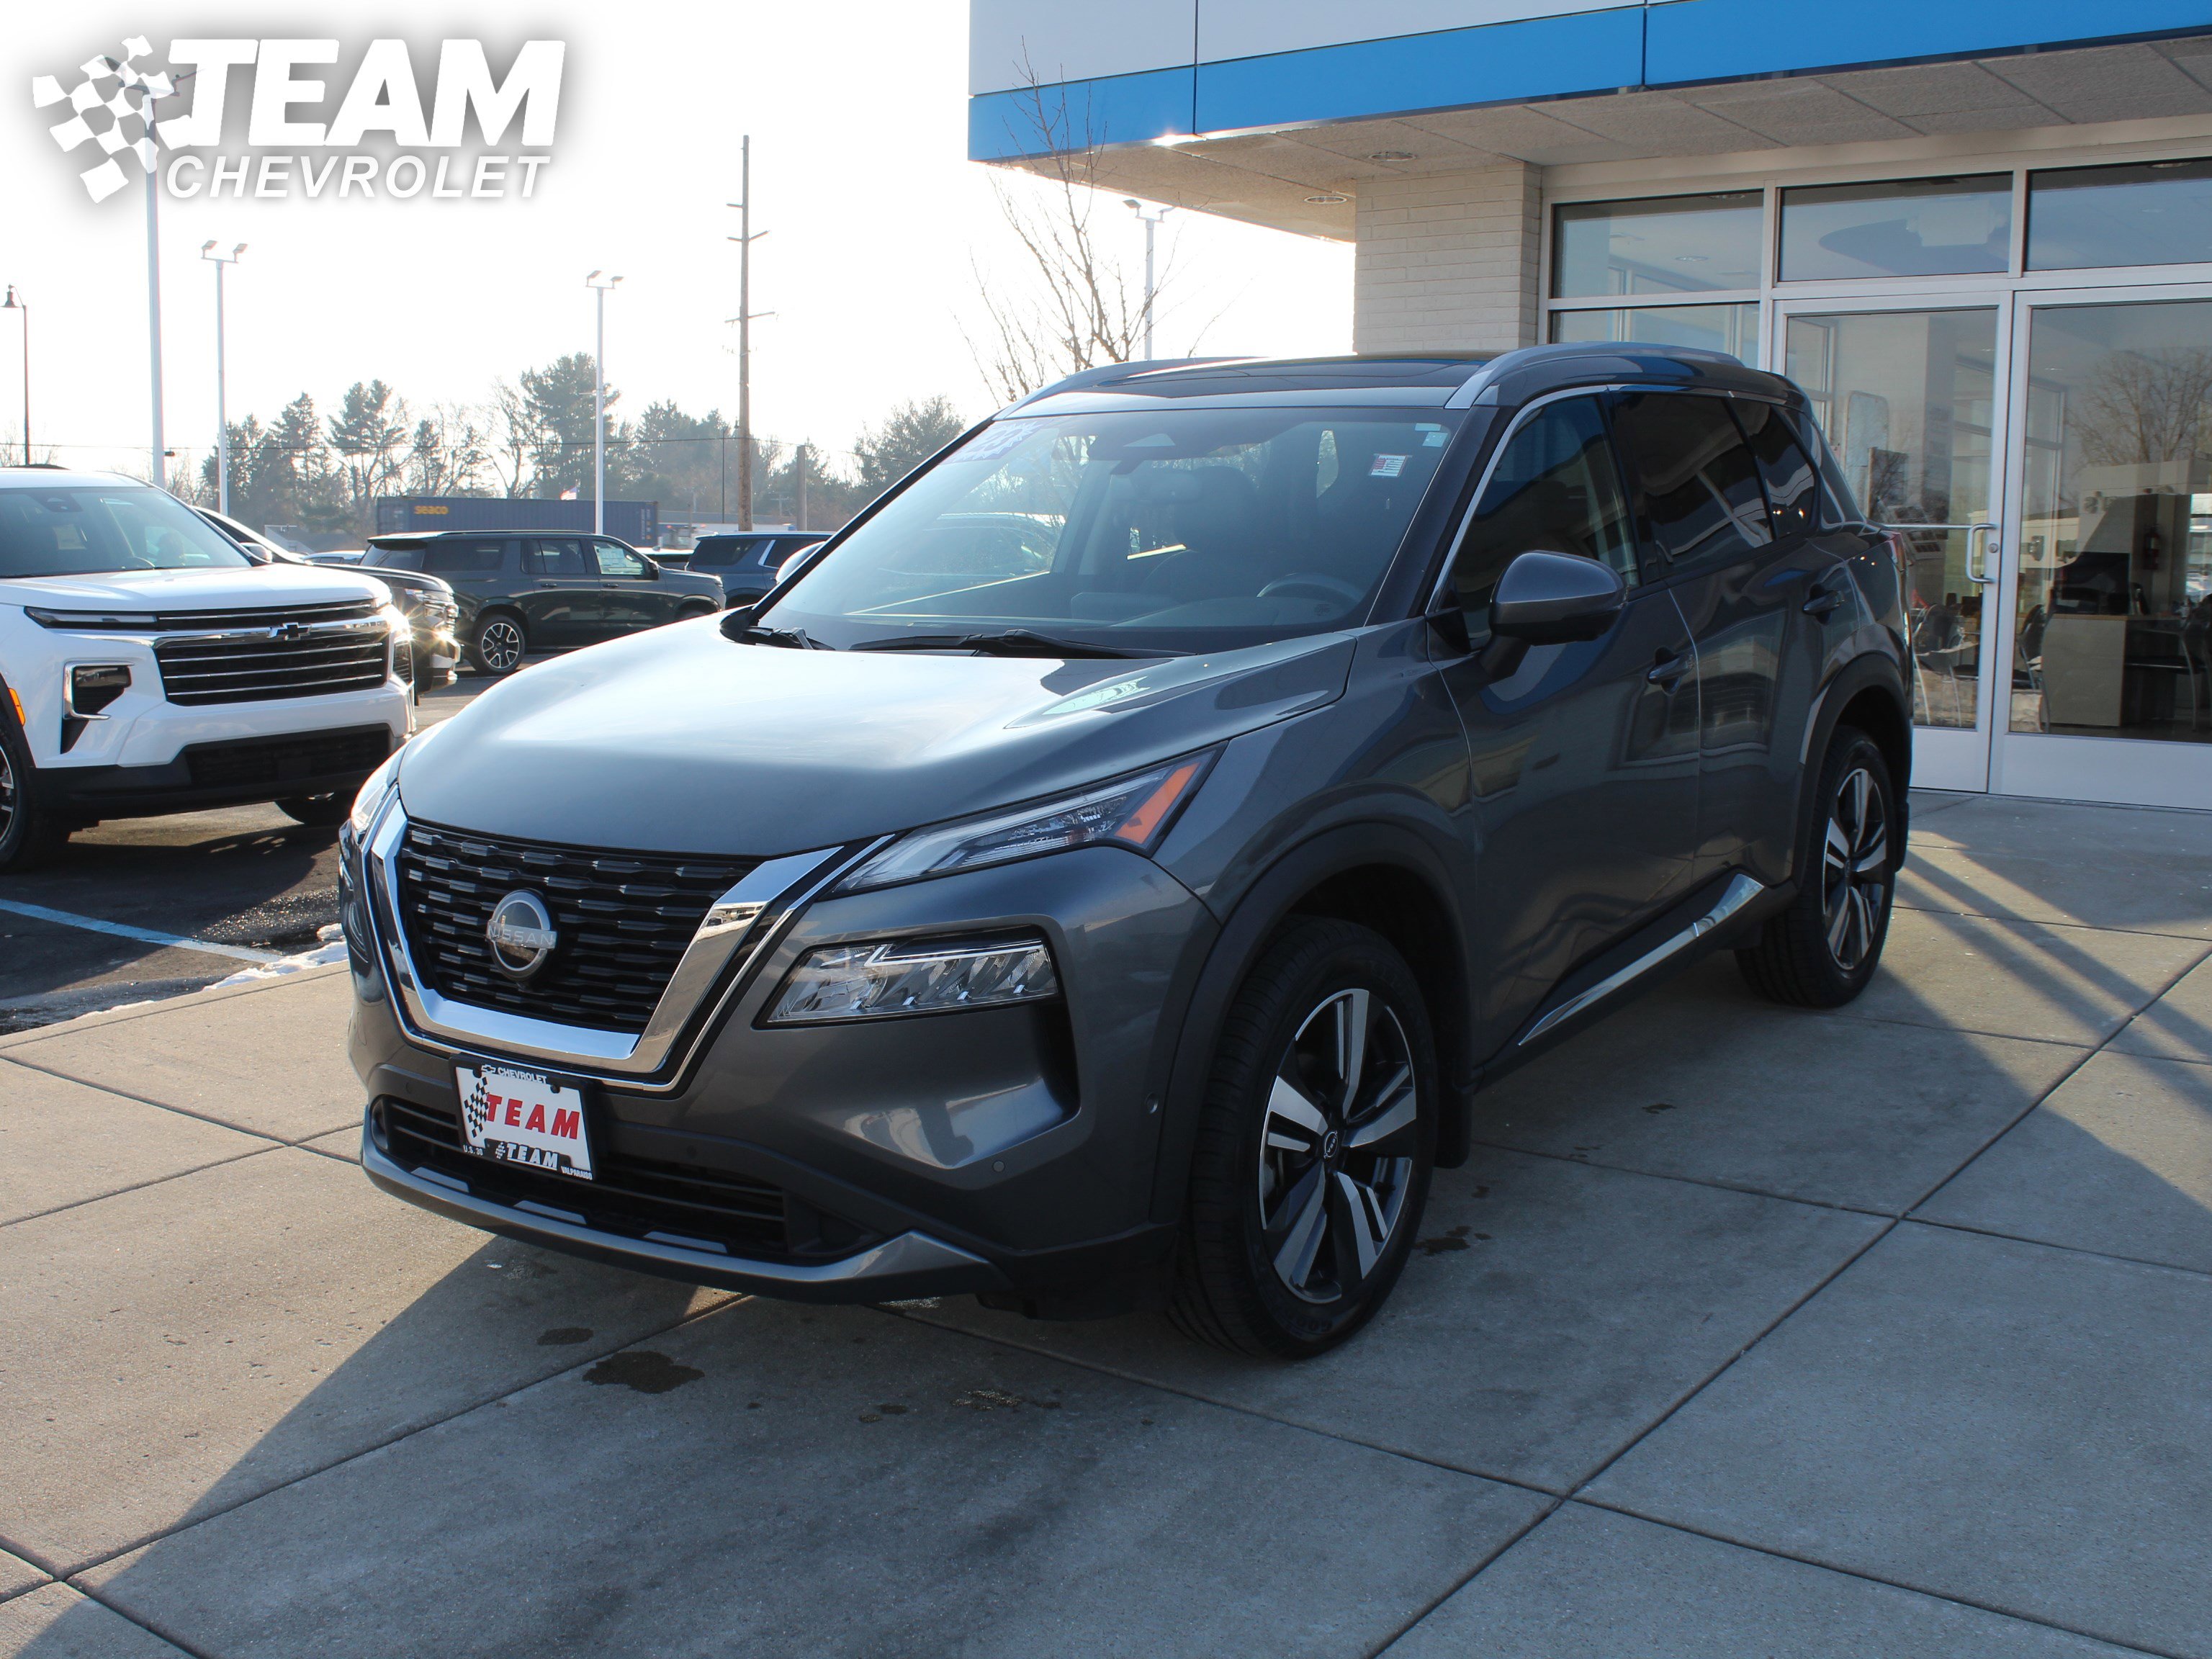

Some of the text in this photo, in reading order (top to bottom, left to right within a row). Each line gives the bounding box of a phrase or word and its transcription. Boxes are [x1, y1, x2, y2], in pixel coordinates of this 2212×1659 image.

[488, 925, 554, 945] NISSAN
[497, 1066, 547, 1084] CHEVROLET
[486, 1093, 580, 1140] TEAM
[506, 1142, 558, 1169] TEAM
[560, 1166, 593, 1180] VALPARAISO
